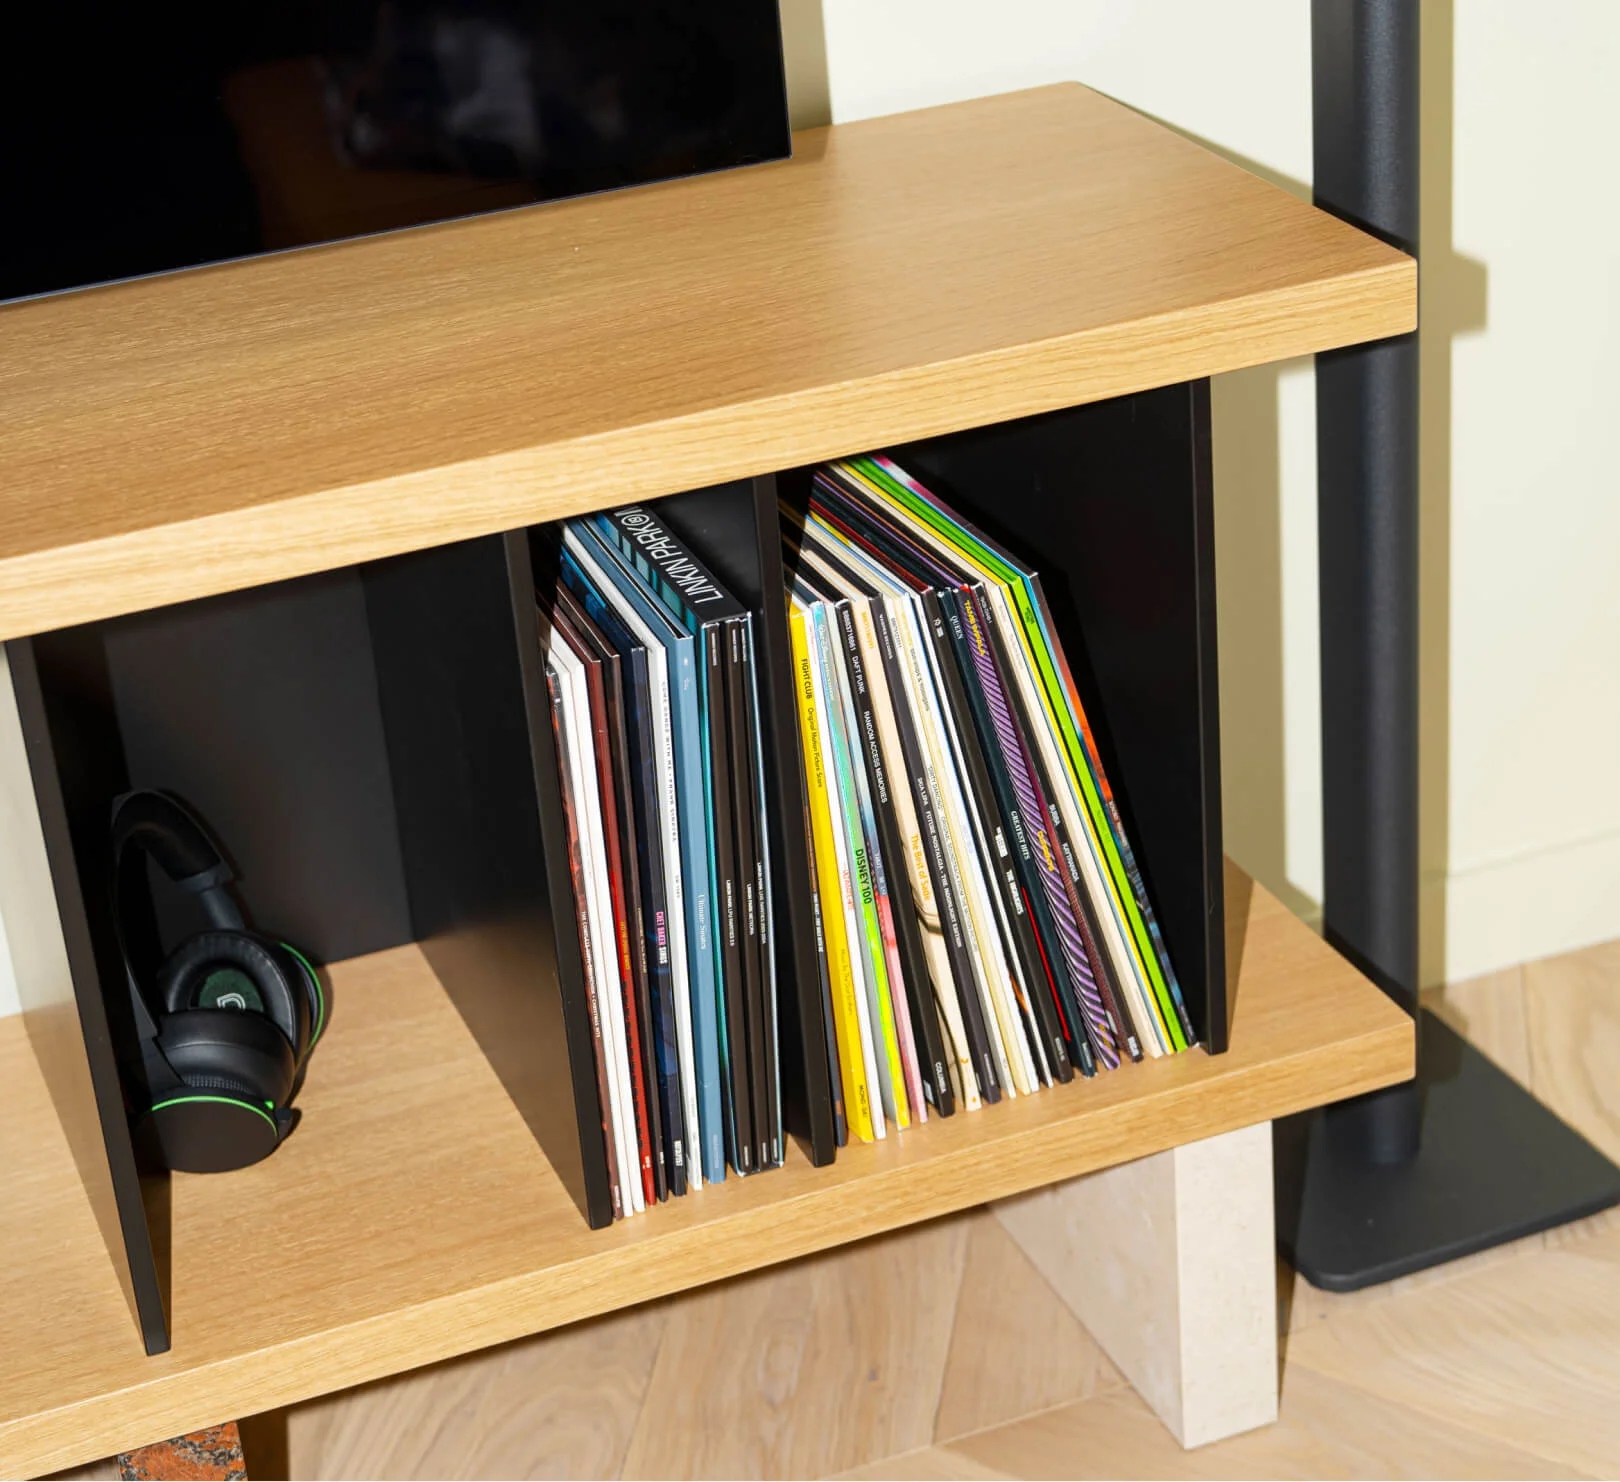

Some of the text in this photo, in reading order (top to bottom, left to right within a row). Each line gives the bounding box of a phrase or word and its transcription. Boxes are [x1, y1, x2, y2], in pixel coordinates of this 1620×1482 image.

[626, 521, 724, 604] LINKIN PARK
[950, 614, 963, 640] QUEEN
[963, 600, 986, 656] TAME IMPALA
[800, 658, 812, 699] FIGHT CLUB
[852, 655, 864, 694] DAFT PUNK
[807, 706, 815, 730] Original
[813, 752, 821, 771] Picture
[862, 710, 887, 803] RANDOM ACCESS MEMORIES
[815, 771, 823, 787] Score
[909, 833, 920, 851] The
[925, 810, 943, 869] FUTURE NOSTALGIA
[1010, 810, 1031, 860] GREATEST HITS
[913, 850, 925, 869] Best
[918, 869, 927, 879] of
[854, 848, 872, 904] DISNEY 100
[656, 912, 664, 925] CHET
[658, 927, 666, 945] BAKER
[936, 1061, 945, 1094] COLUMBIA
